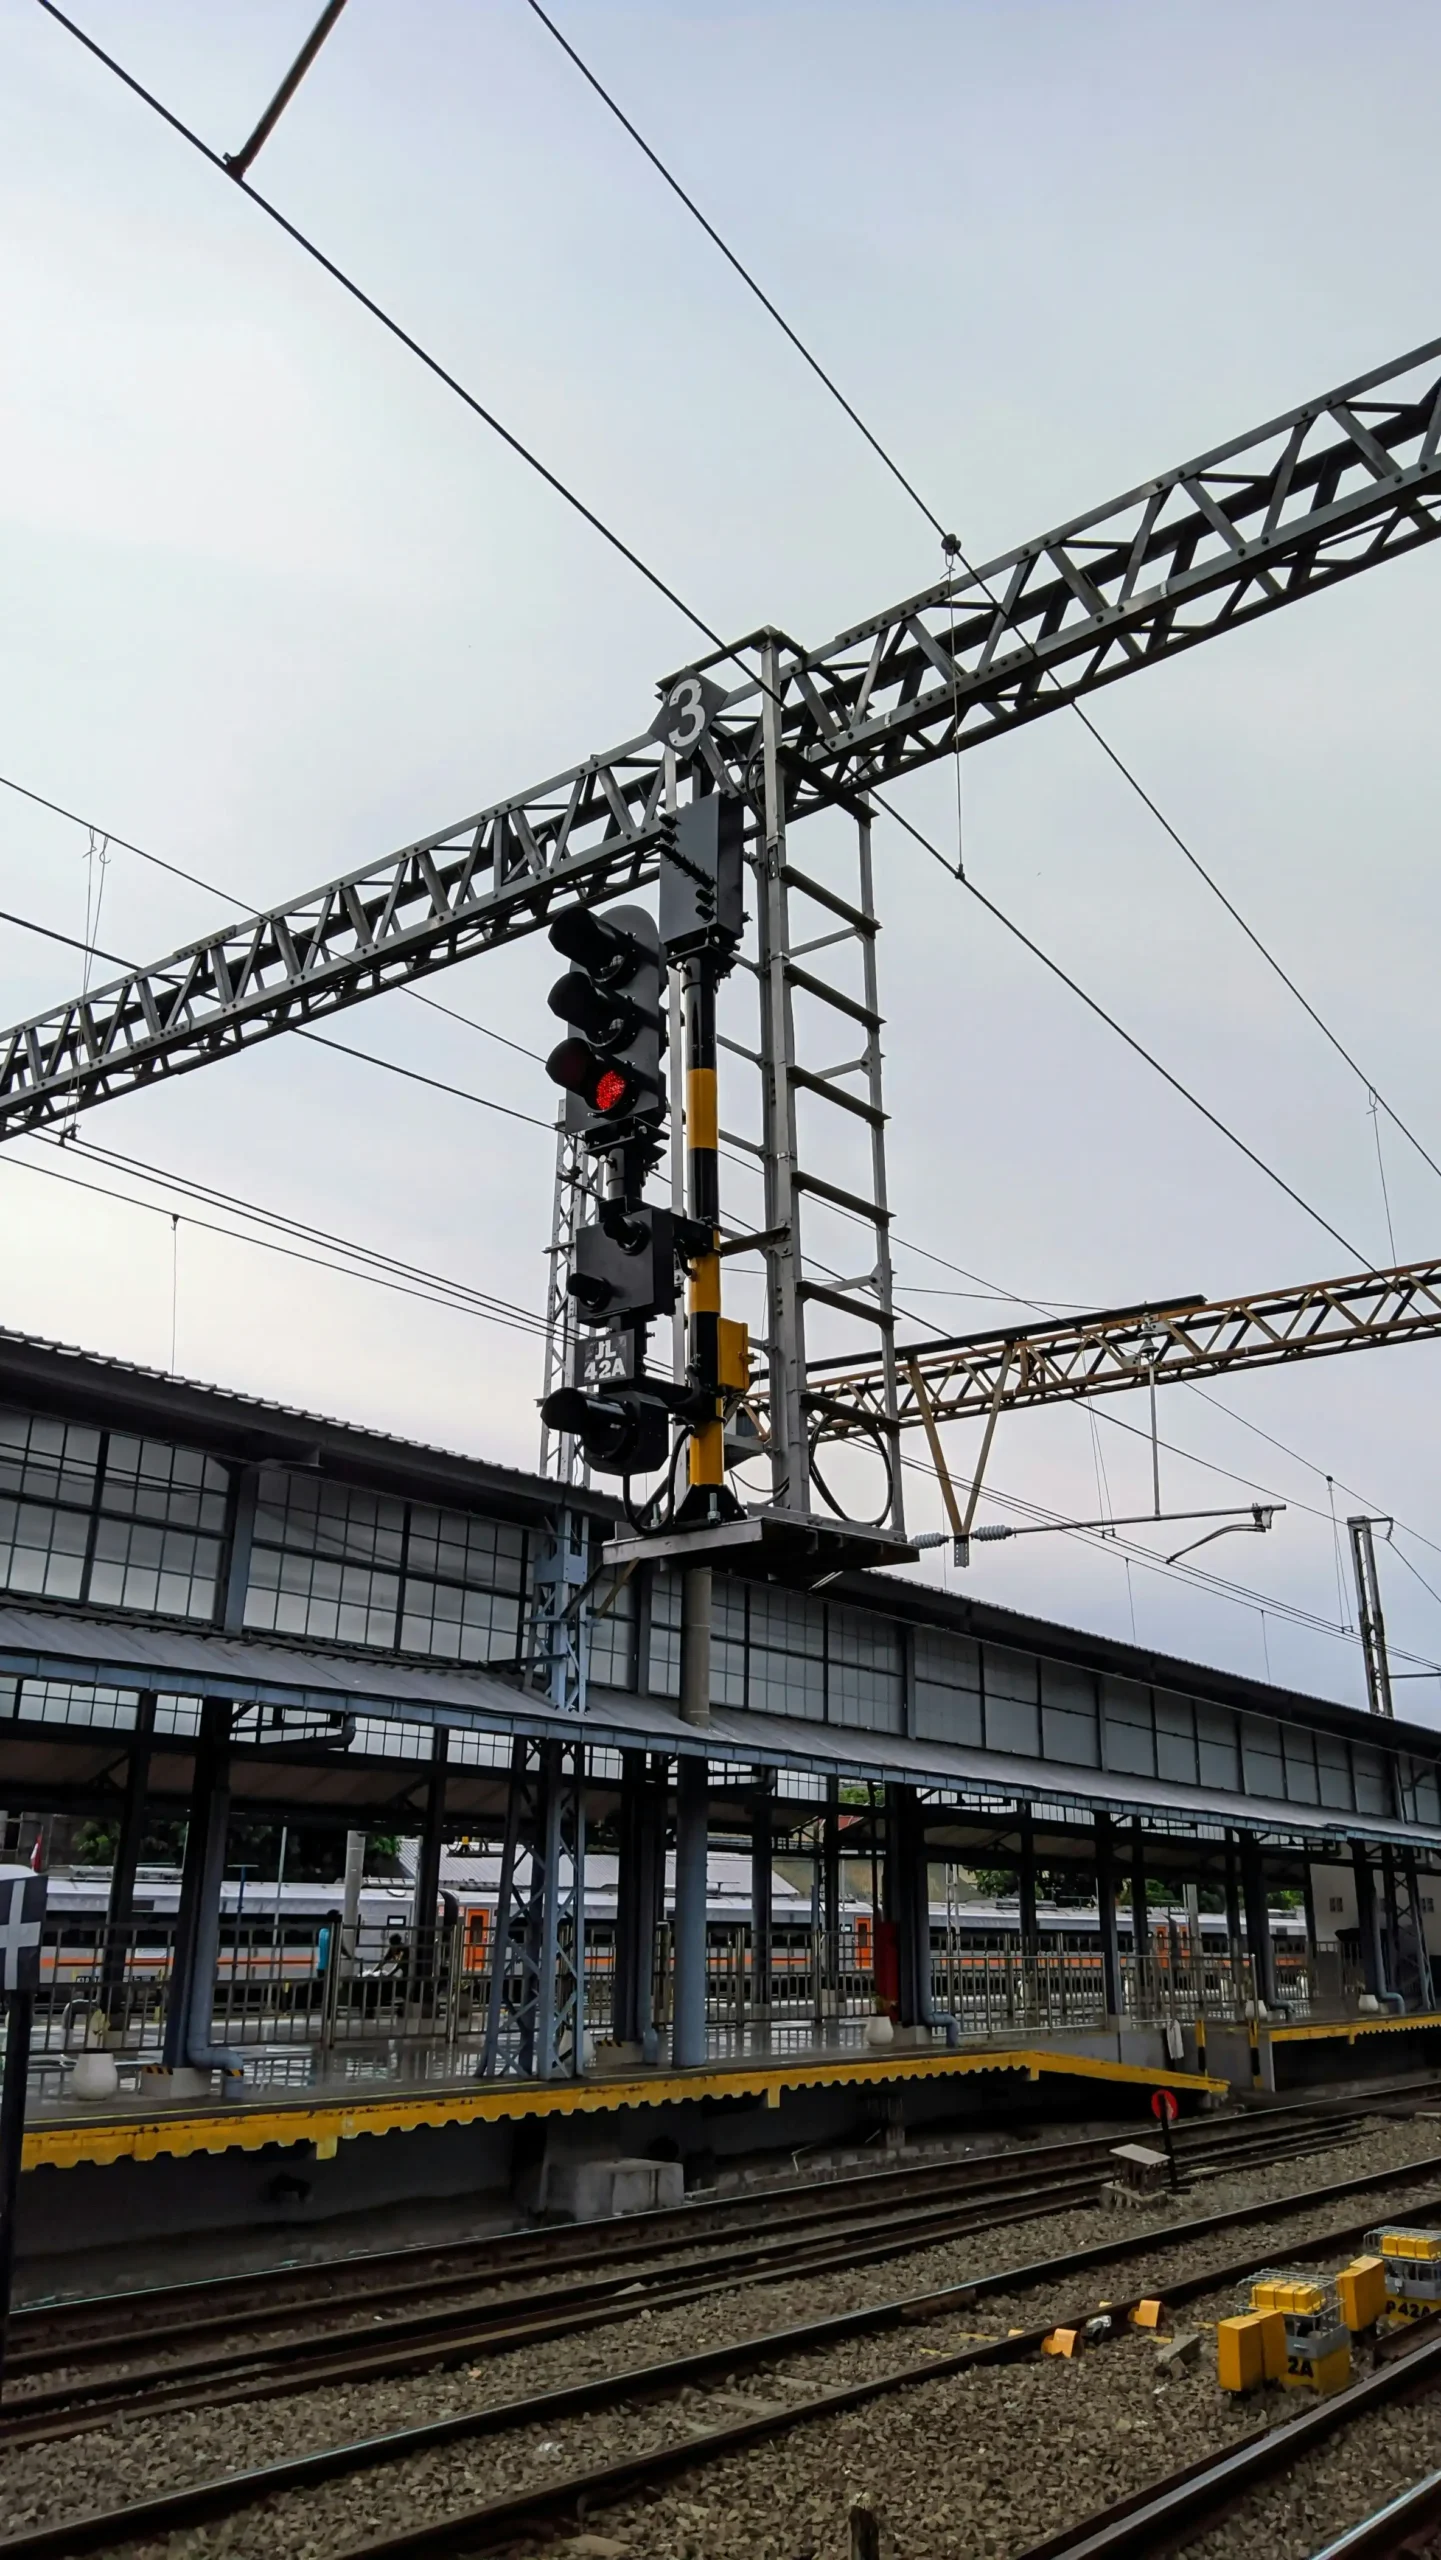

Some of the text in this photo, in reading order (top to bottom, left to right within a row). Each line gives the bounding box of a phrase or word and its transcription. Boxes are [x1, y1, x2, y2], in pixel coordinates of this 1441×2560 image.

[668, 678, 706, 747] 3
[595, 1339, 617, 1360] JL
[584, 1358, 626, 1380] 42A
